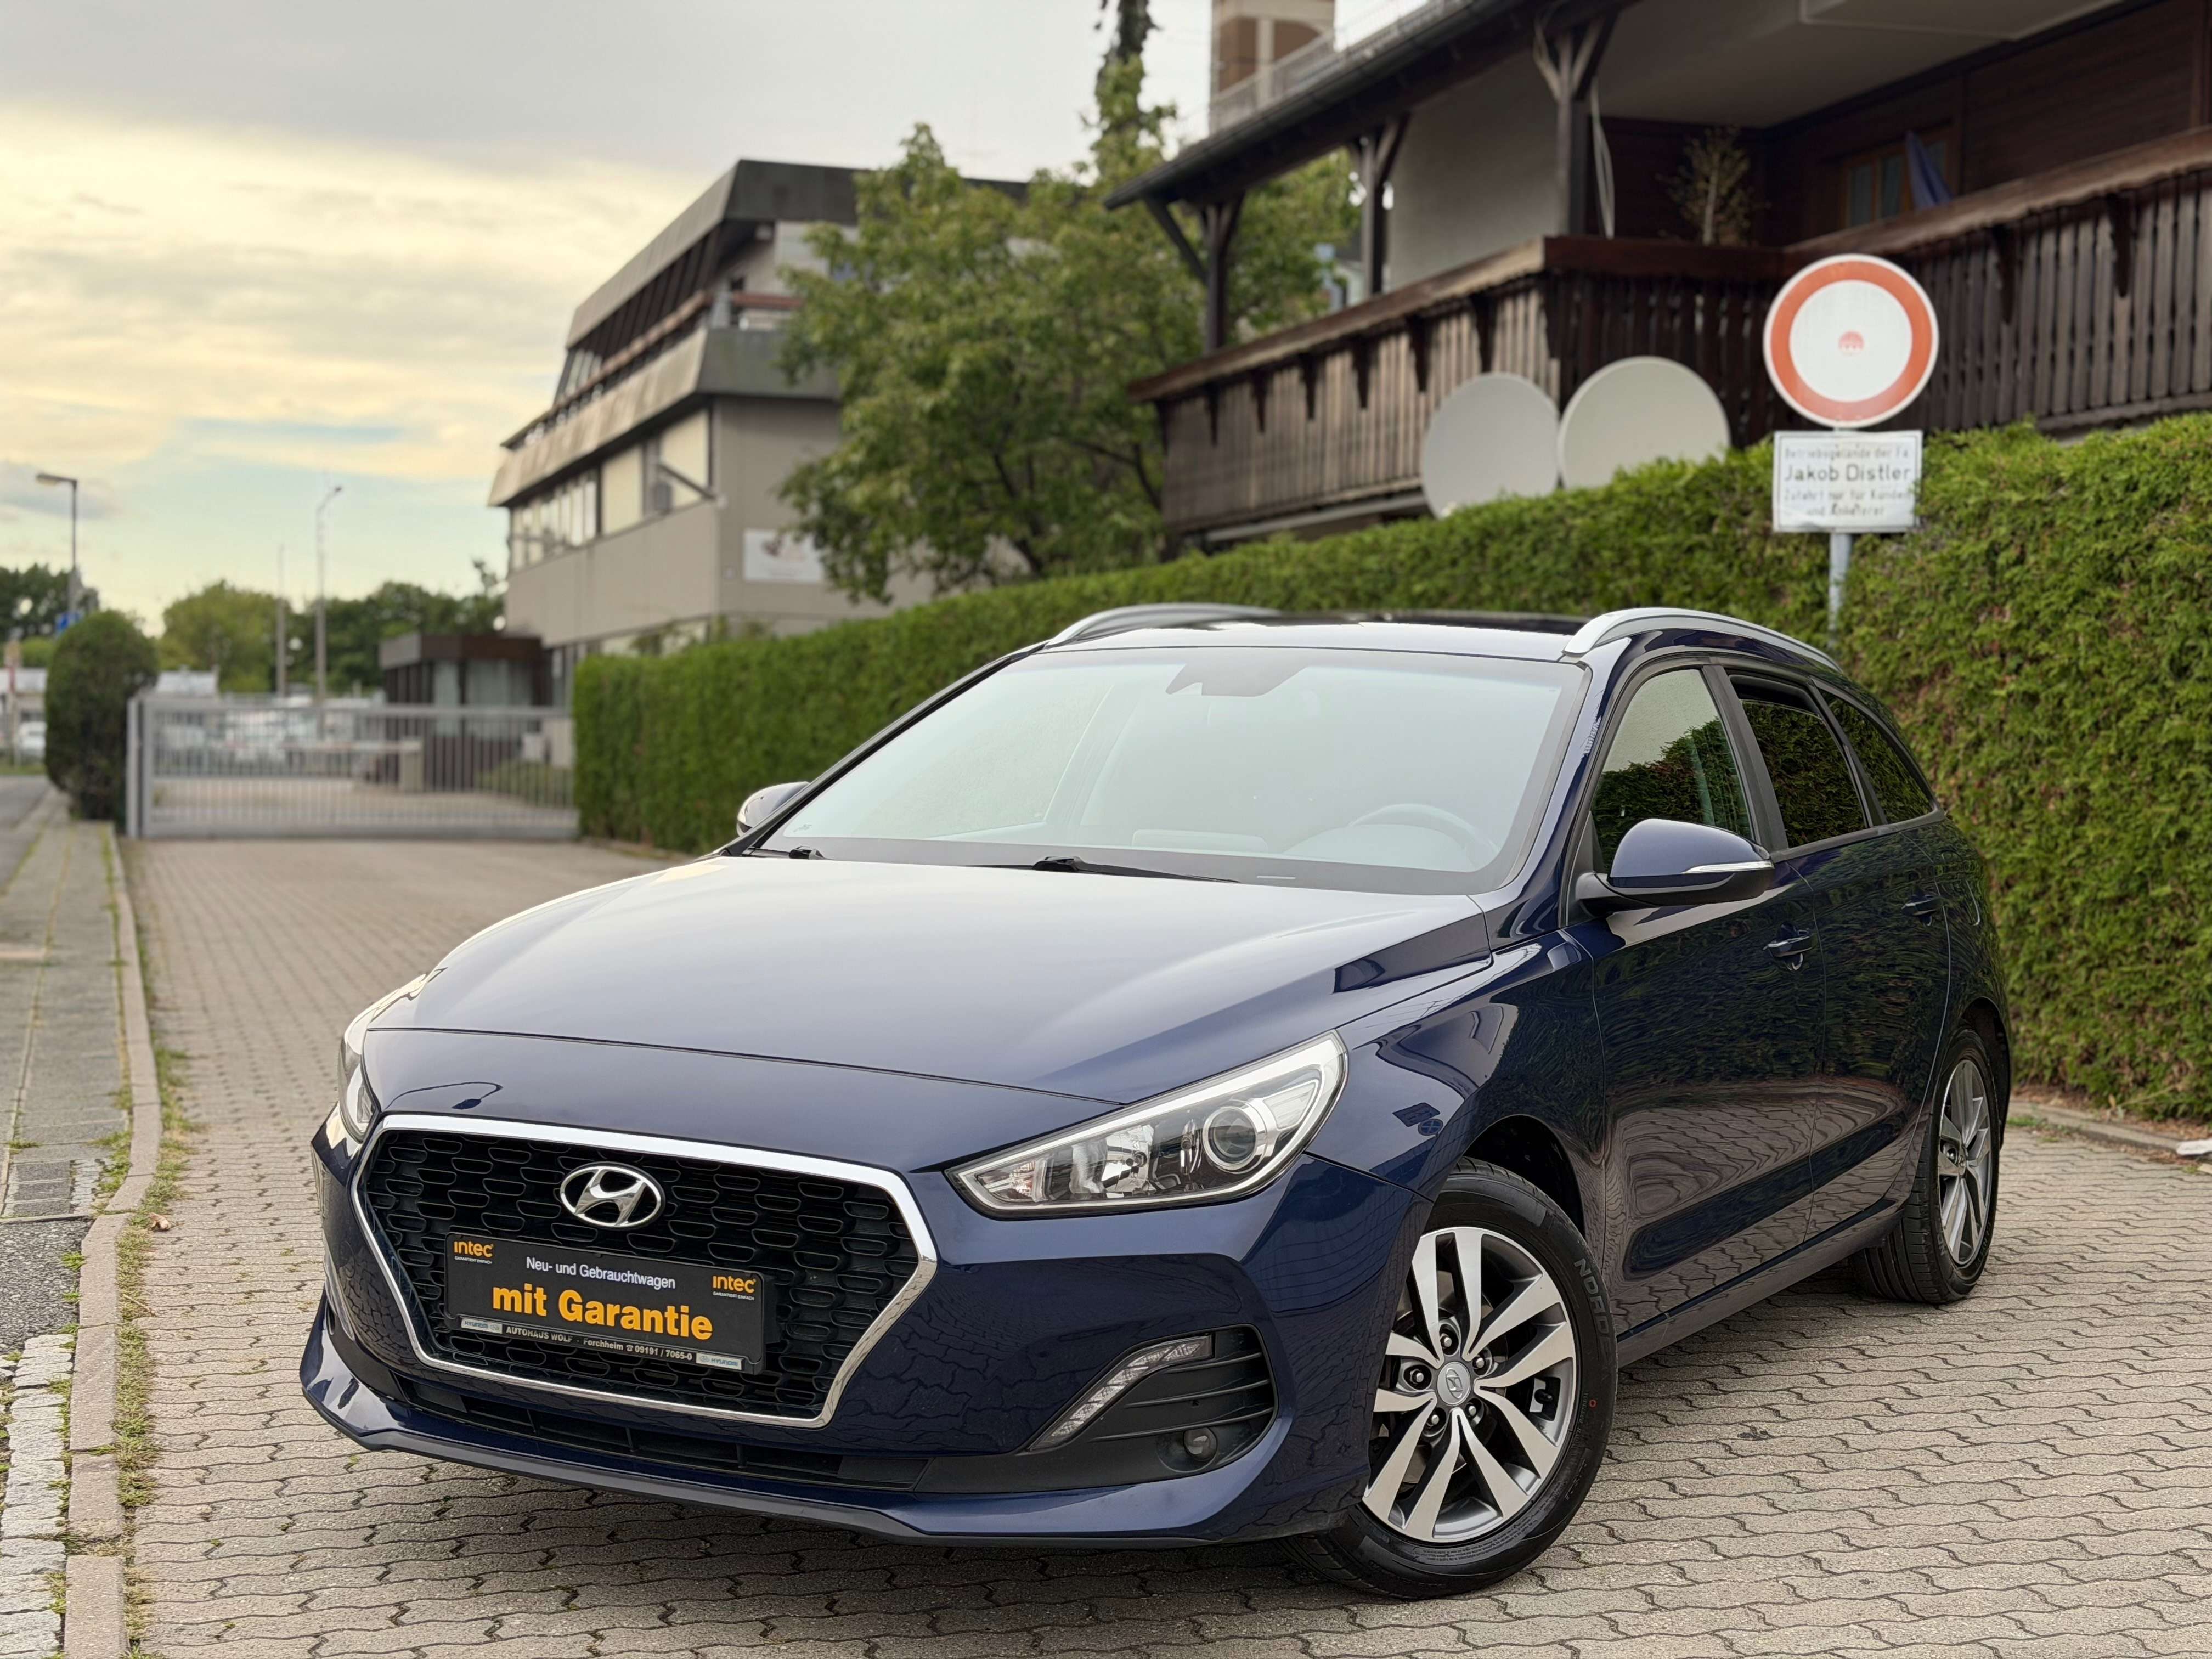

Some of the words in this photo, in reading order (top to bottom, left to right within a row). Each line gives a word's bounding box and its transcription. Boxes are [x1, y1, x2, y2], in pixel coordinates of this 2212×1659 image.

[1784, 465, 1839, 482] Jakob
[1846, 464, 1911, 482] Distler
[454, 1241, 492, 1257] intec
[526, 1256, 552, 1272] Neu-
[556, 1263, 577, 1276] und
[579, 1264, 675, 1290] Gebrauchtwagen
[712, 1275, 755, 1293] intec
[493, 1283, 547, 1317] mit
[558, 1289, 713, 1340] Garantie
[506, 1326, 549, 1339] AUTOHAUS
[551, 1334, 573, 1342] WOLF
[583, 1338, 623, 1351] Forchheim
[635, 1346, 659, 1356] 09191
[665, 1350, 692, 1361] 7065-0
[710, 1358, 738, 1367] HYUNDAI
